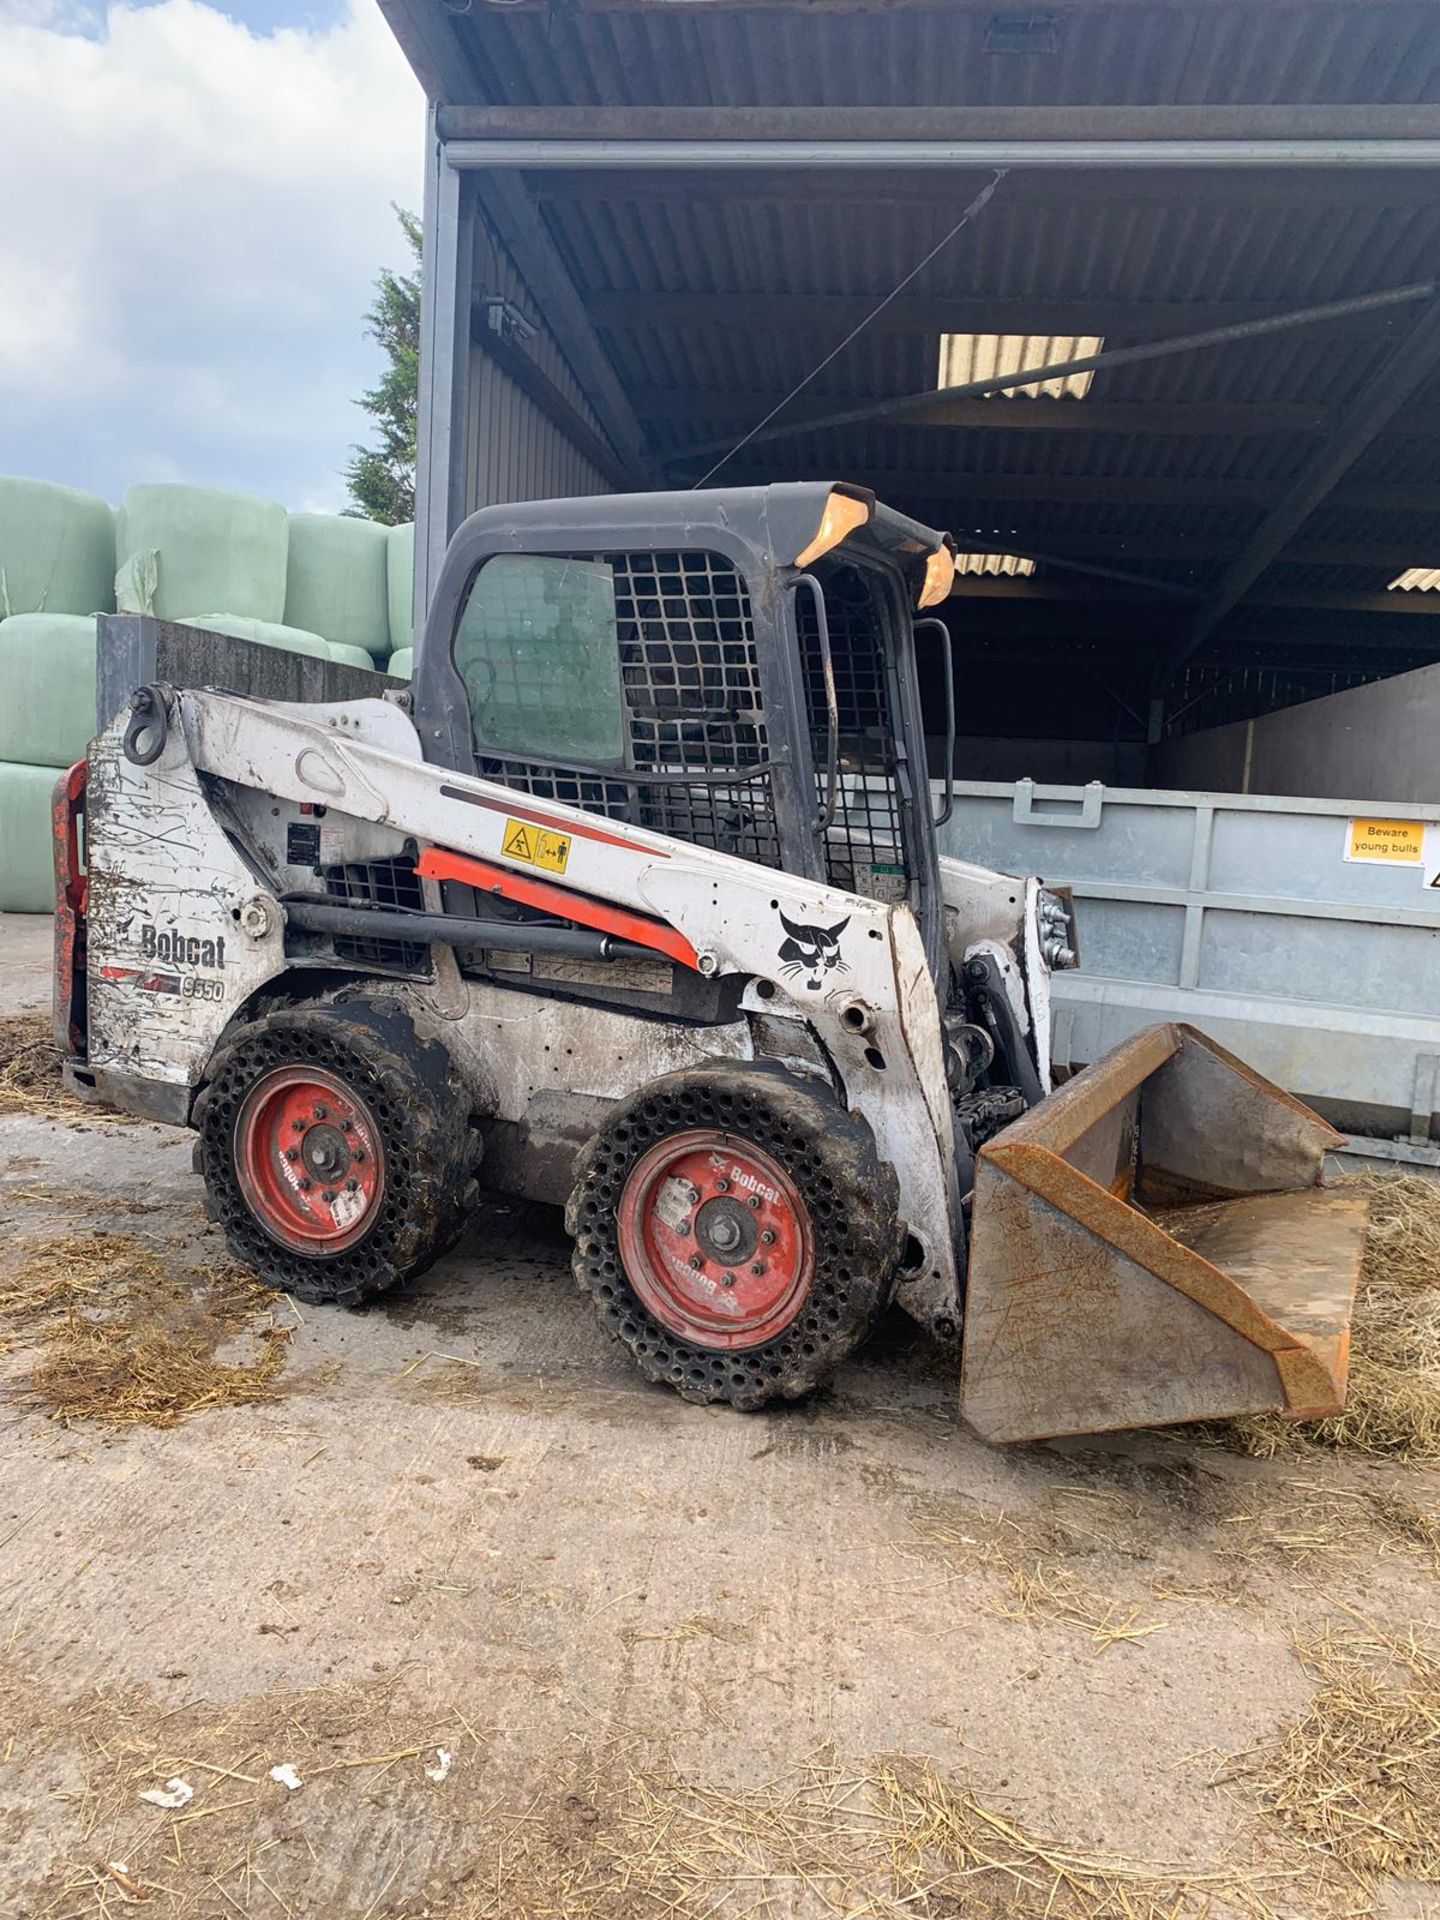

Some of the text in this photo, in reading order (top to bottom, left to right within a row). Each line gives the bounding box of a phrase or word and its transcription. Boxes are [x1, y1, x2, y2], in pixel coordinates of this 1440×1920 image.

[1367, 826, 1409, 838] Beware
[1355, 842, 1419, 854] young bulls
[141, 924, 226, 970] Bobcat
[730, 1165, 780, 1205] Bobcat
